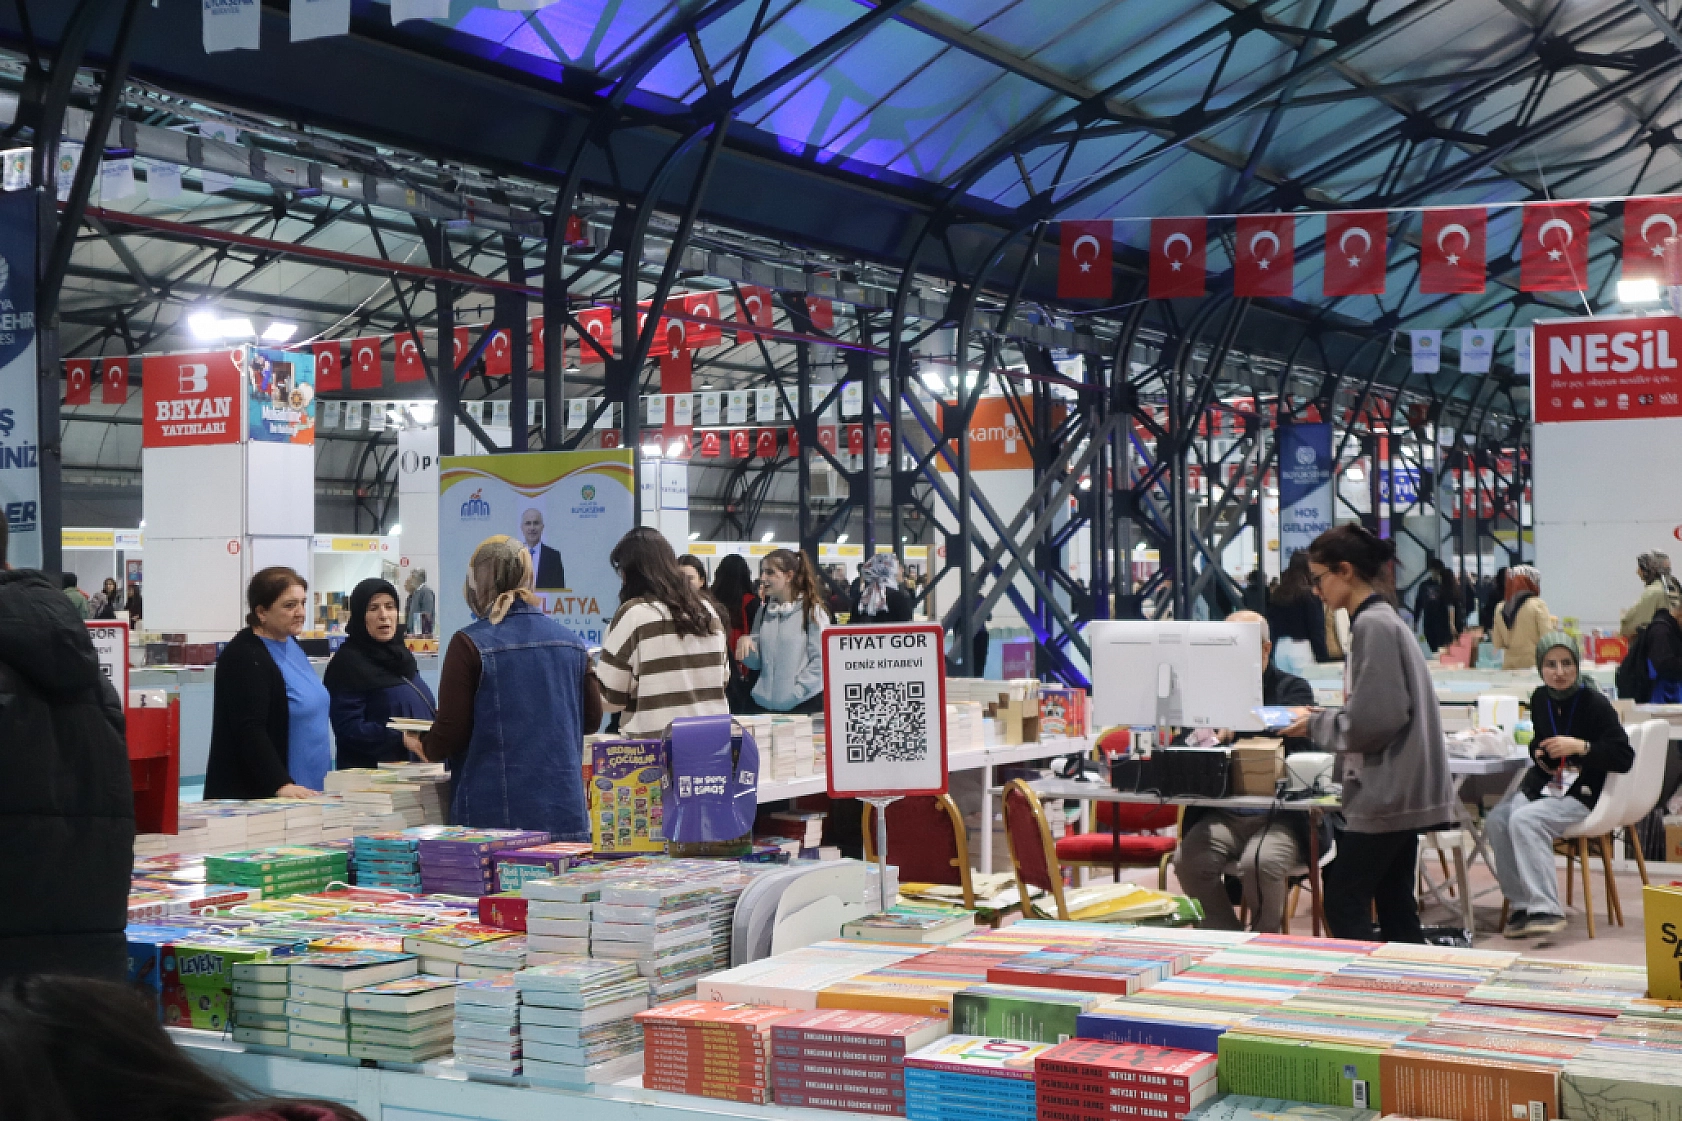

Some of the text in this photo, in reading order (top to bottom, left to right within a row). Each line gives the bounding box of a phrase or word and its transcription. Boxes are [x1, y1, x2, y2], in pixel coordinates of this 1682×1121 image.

[155, 396, 232, 421] BEYAN
[161, 421, 226, 436] YAYINLARI
[1294, 507, 1319, 519] HOŞ
[541, 597, 600, 615] LATYA
[839, 632, 927, 651] FİYAT GÖR
[844, 657, 923, 671] DENİZ KİTABEVİ
[179, 953, 224, 976] LEVENT
[1040, 1063, 1079, 1075] PSİKOLOJİK
[1041, 1079, 1080, 1091] PSİKOLOJİK
[1042, 1095, 1080, 1106] PSİKOLOJİK
